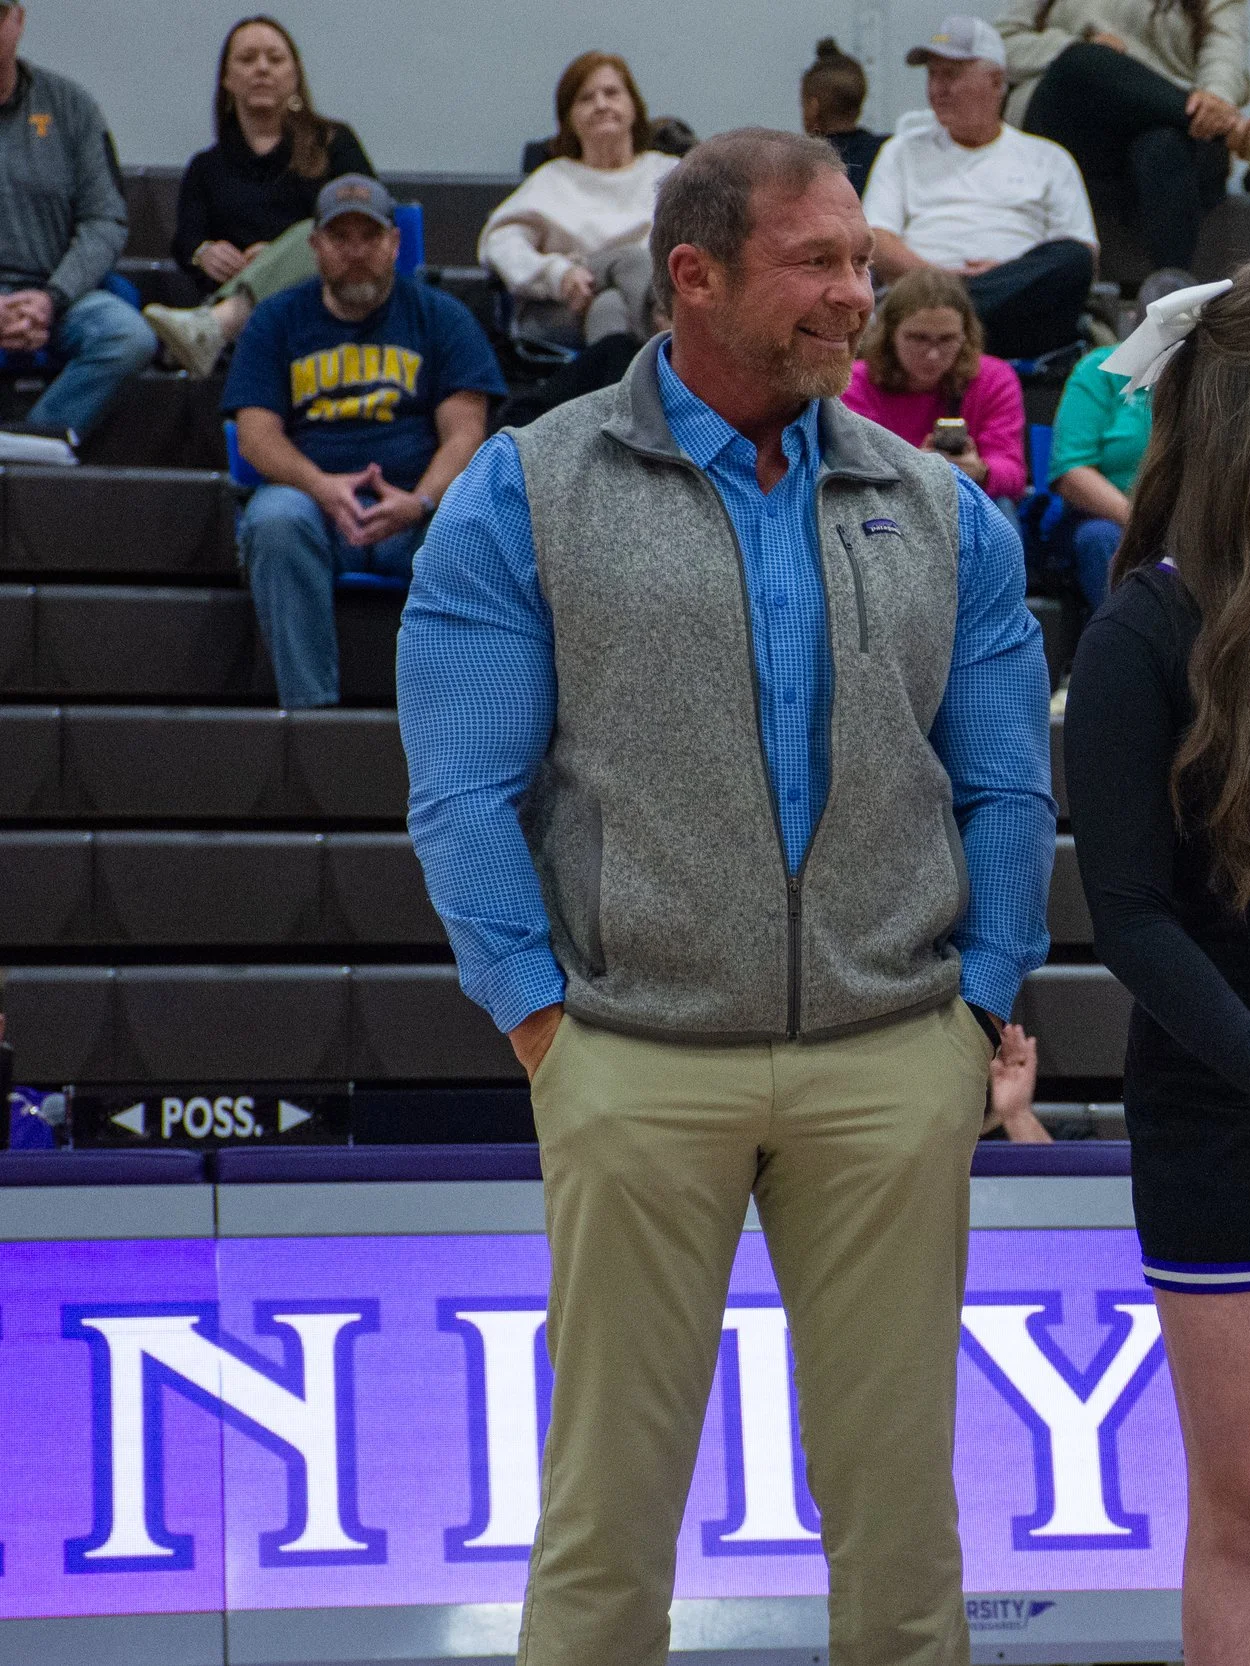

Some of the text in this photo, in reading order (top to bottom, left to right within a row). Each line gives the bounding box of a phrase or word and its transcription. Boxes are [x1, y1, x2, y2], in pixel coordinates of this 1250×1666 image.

[291, 343, 423, 409] MURRAY
[161, 1096, 263, 1139] POSS.
[966, 1600, 1024, 1619] RSITY
